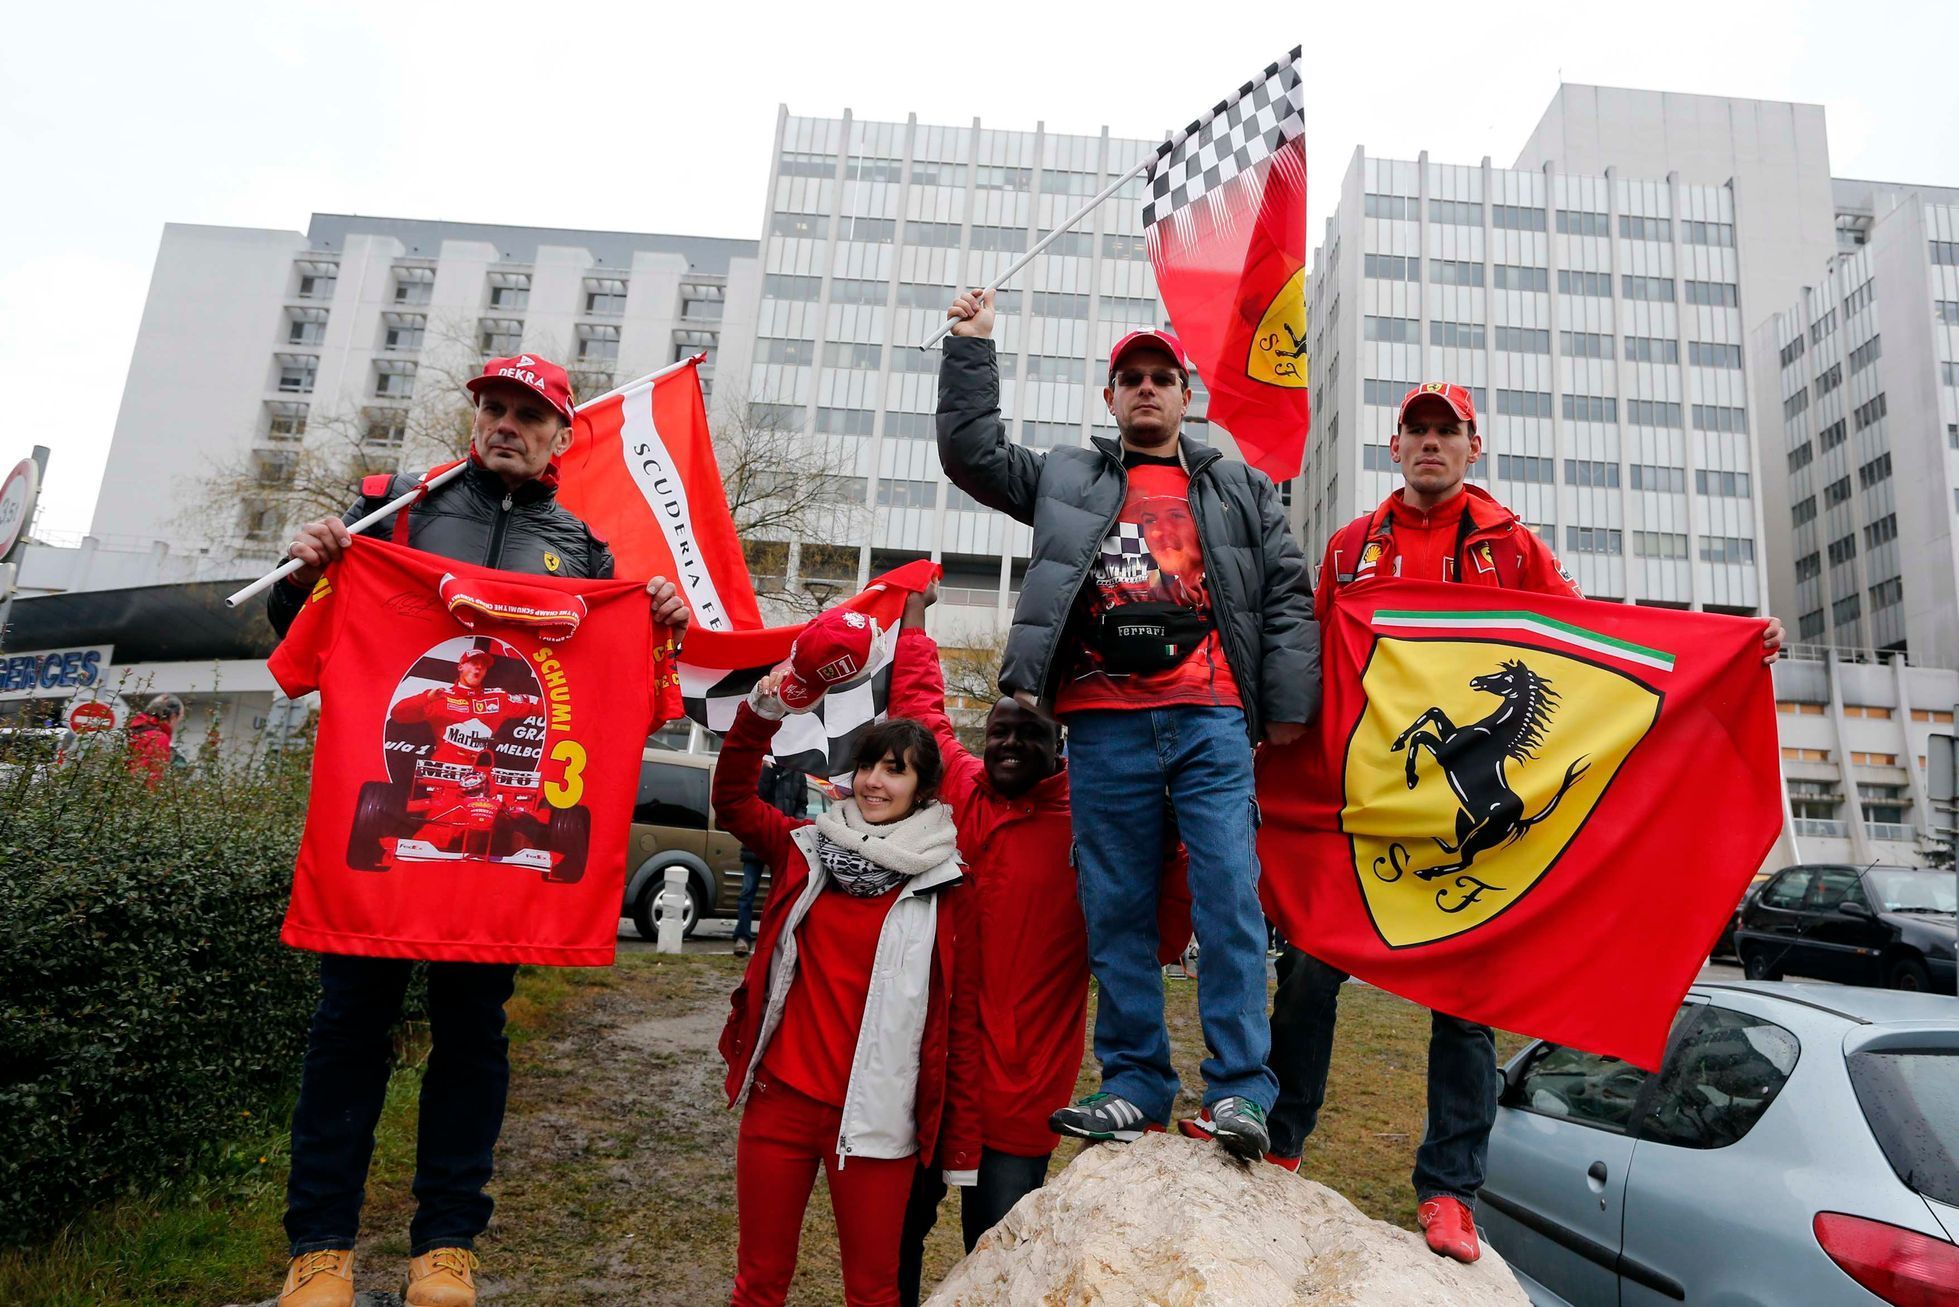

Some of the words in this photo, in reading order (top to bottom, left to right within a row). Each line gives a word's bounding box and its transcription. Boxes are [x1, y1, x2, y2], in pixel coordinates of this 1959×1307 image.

[498, 368, 545, 390] DEKRA
[634, 442, 701, 588] SCUDERIA
[702, 601, 723, 631] FE
[494, 604, 508, 612] THE
[508, 605, 535, 615] SCHUMI
[1117, 625, 1165, 636] Ferrari
[532, 647, 572, 731] SCHUMI
[543, 740, 587, 810] 3
[1373, 842, 1411, 883] S
[1435, 875, 1507, 914] F
